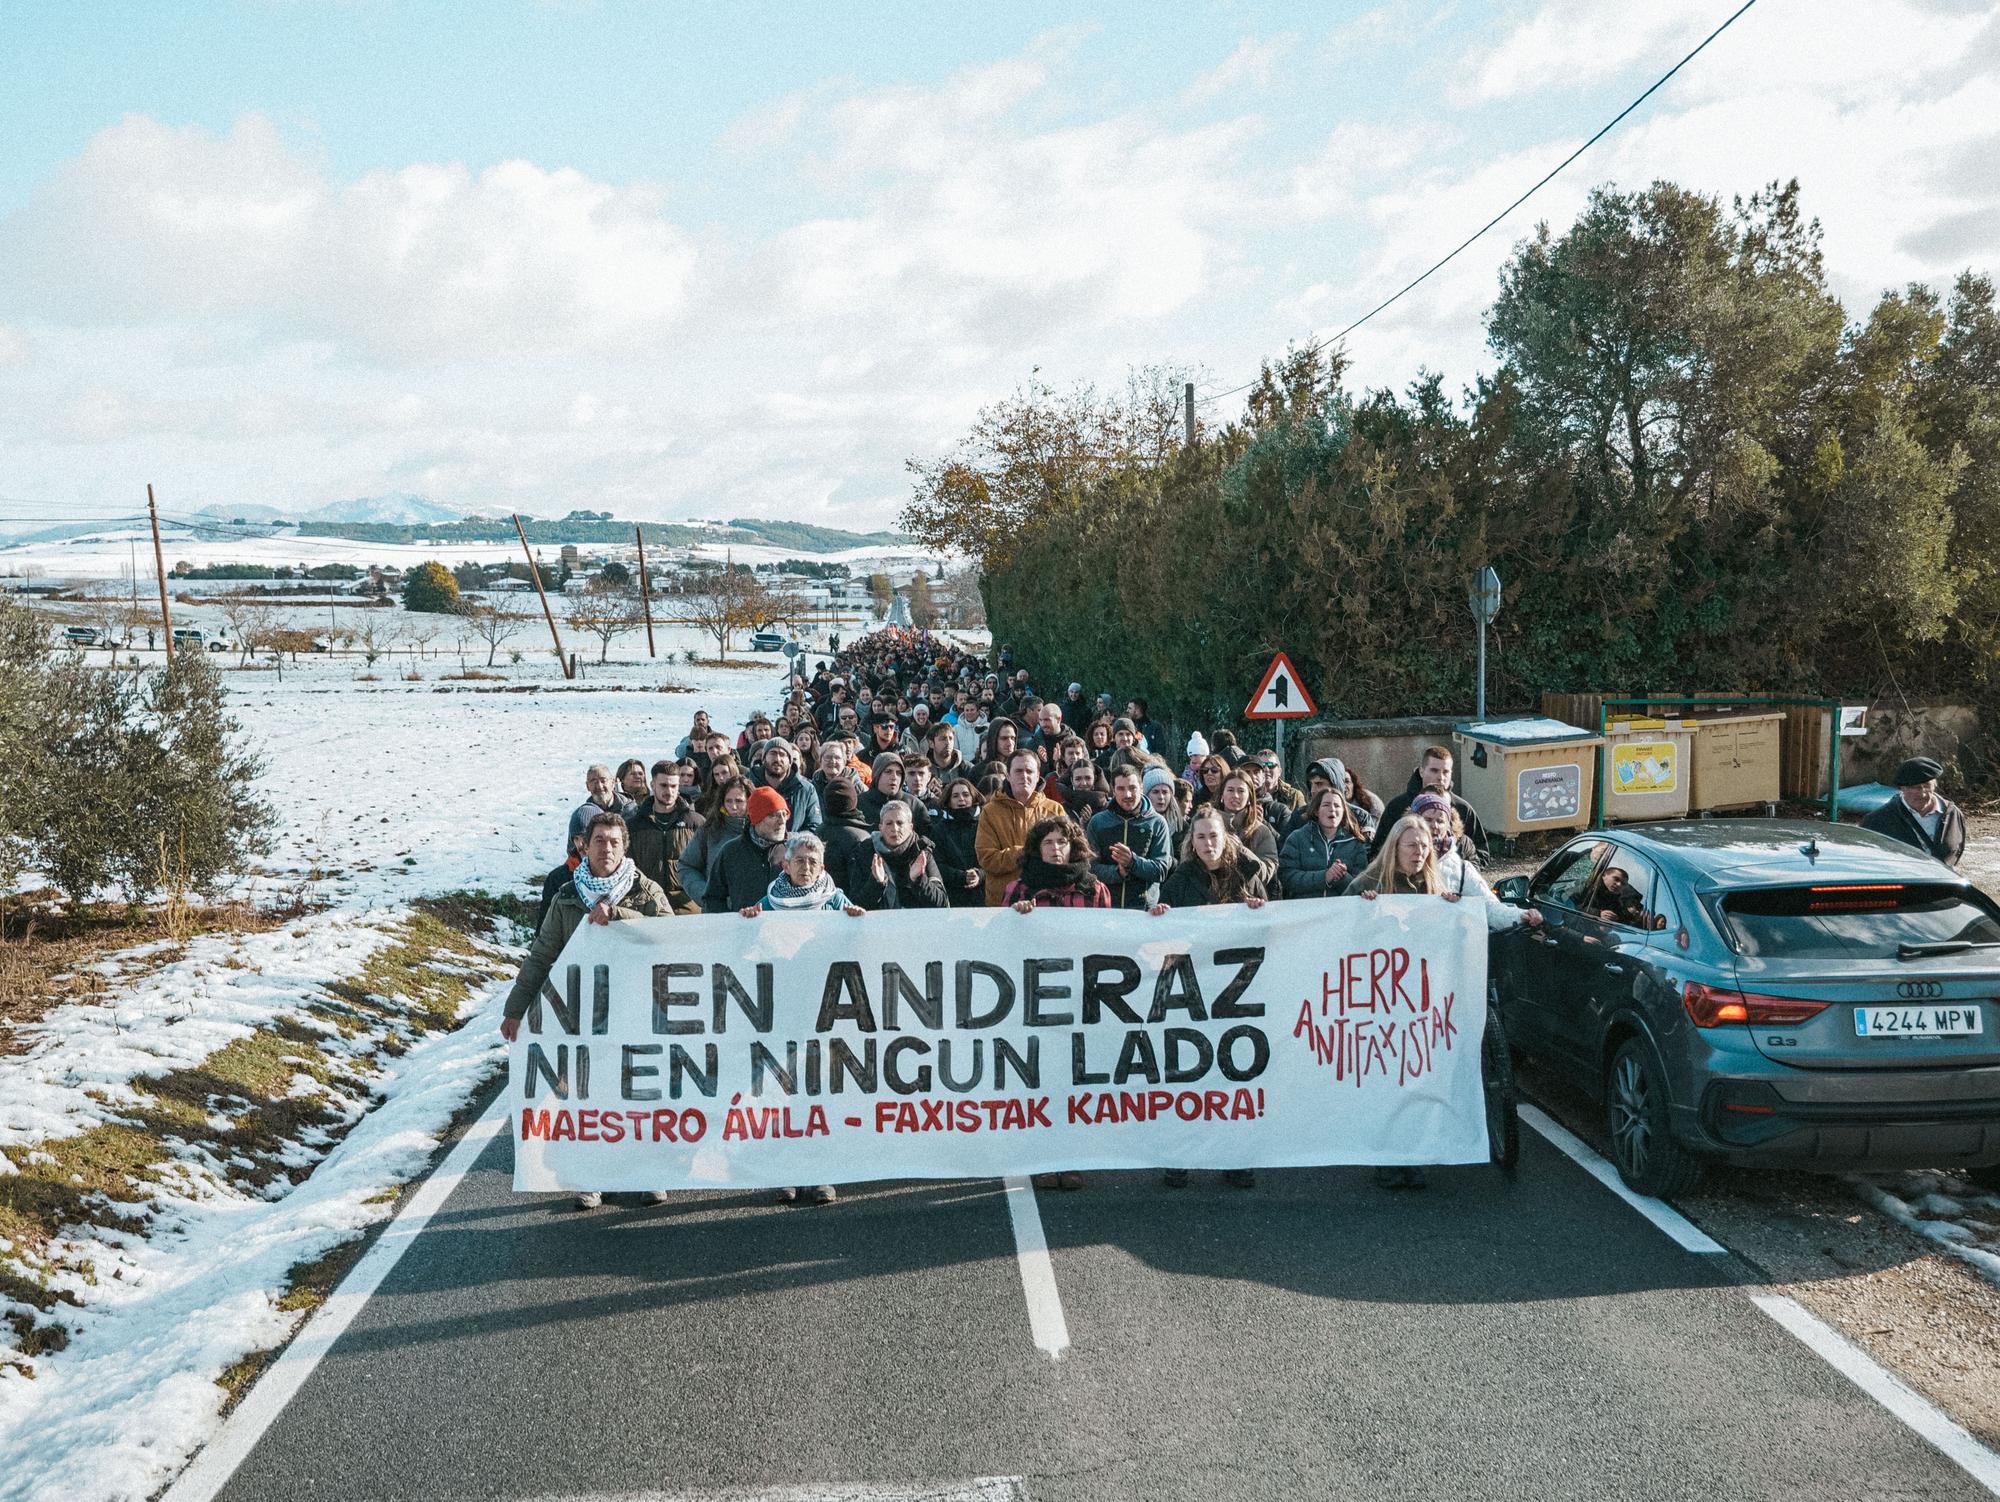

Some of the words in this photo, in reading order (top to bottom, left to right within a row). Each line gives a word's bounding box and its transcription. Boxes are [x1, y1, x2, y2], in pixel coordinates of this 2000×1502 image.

[527, 963, 610, 1035] NI
[652, 962, 774, 1034] EN
[815, 946, 1266, 1034] ANDERAZ
[1322, 947, 1430, 1016] HERRI
[1293, 992, 1458, 1088] ANTIFAXISTAK
[1767, 1036, 1797, 1047] Q3
[1872, 1010, 1927, 1031] 4244
[1934, 1010, 1976, 1030] MPW
[523, 1042, 590, 1100] NI
[620, 1042, 719, 1100] EN
[750, 1035, 1041, 1098] NINGUN
[1071, 1024, 1271, 1085] LADO
[521, 1107, 708, 1143] MAESTRO
[722, 1092, 830, 1142] ÁVILA
[875, 1096, 1052, 1133] FAXISTAK
[1067, 1087, 1265, 1125] KANPORA!
